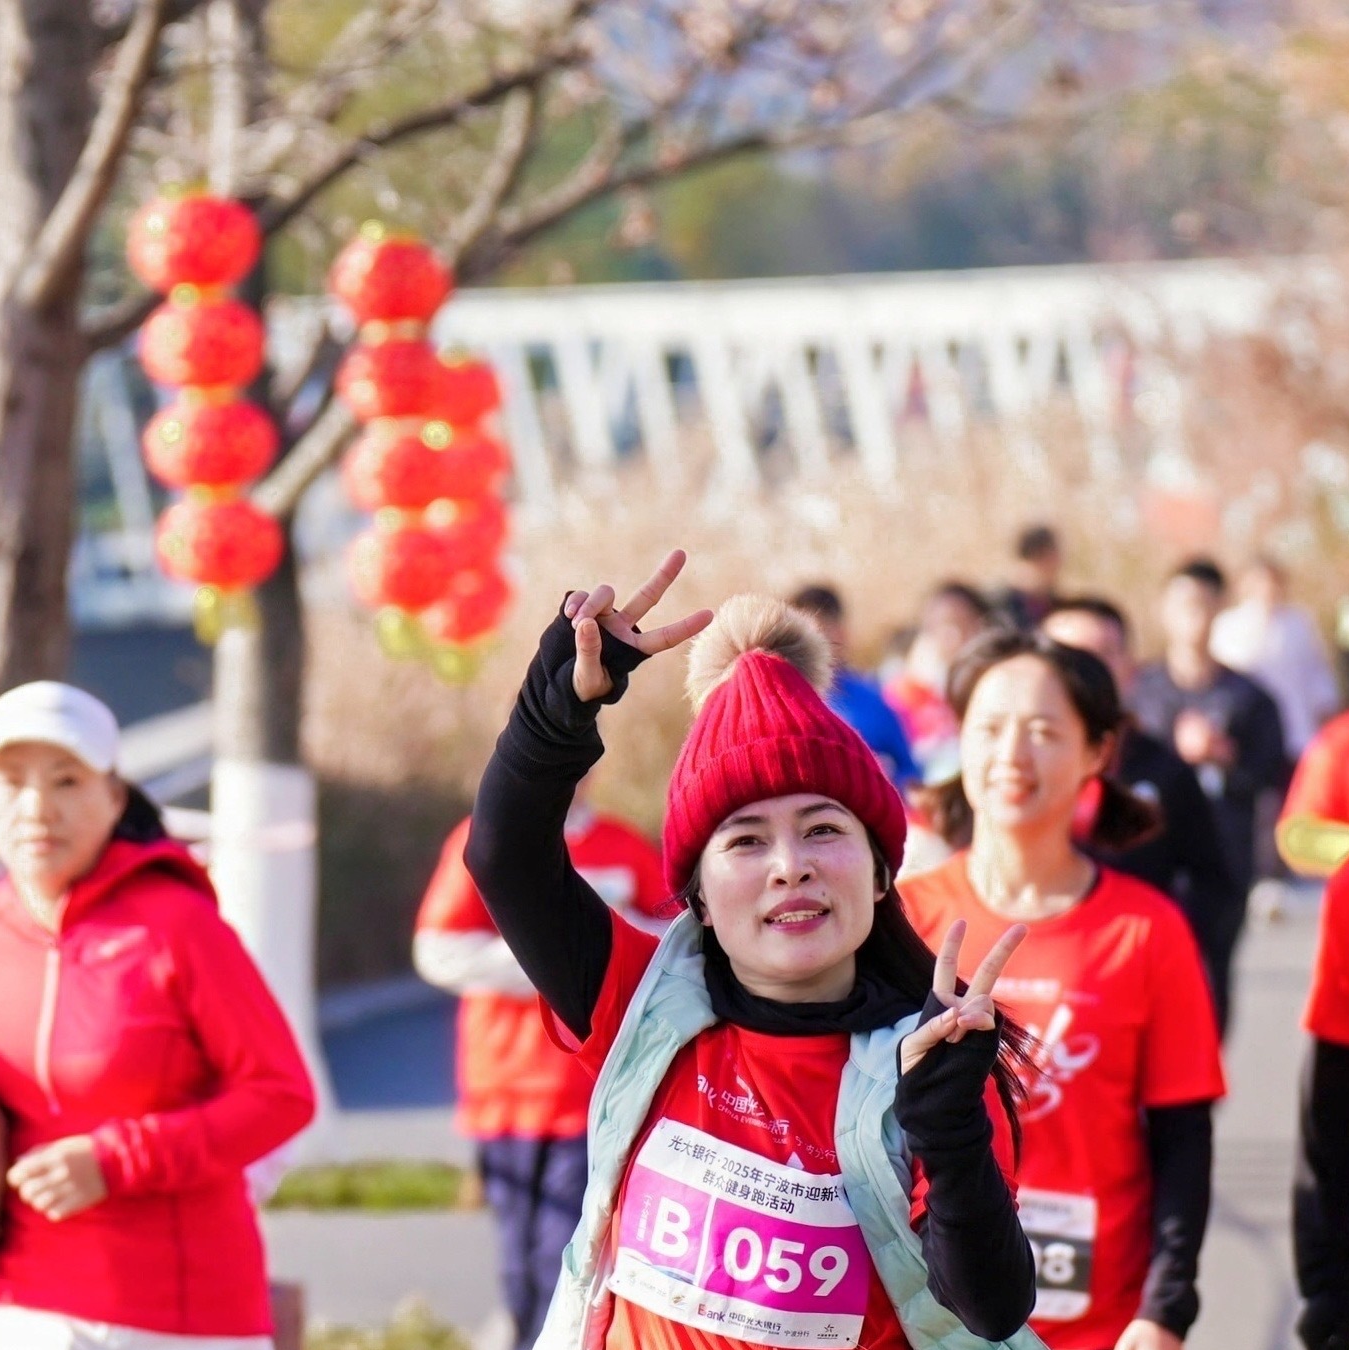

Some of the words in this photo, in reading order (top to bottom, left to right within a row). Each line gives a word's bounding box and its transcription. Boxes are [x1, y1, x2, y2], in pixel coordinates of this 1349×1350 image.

[668, 1134, 841, 1204] 光大银行·2025年宁波市迎新
[702, 1168, 796, 1215] 群众健身跑活动
[650, 1196, 691, 1258] B
[722, 1226, 849, 1298] 059
[728, 1312, 782, 1332] 中国光大银行
